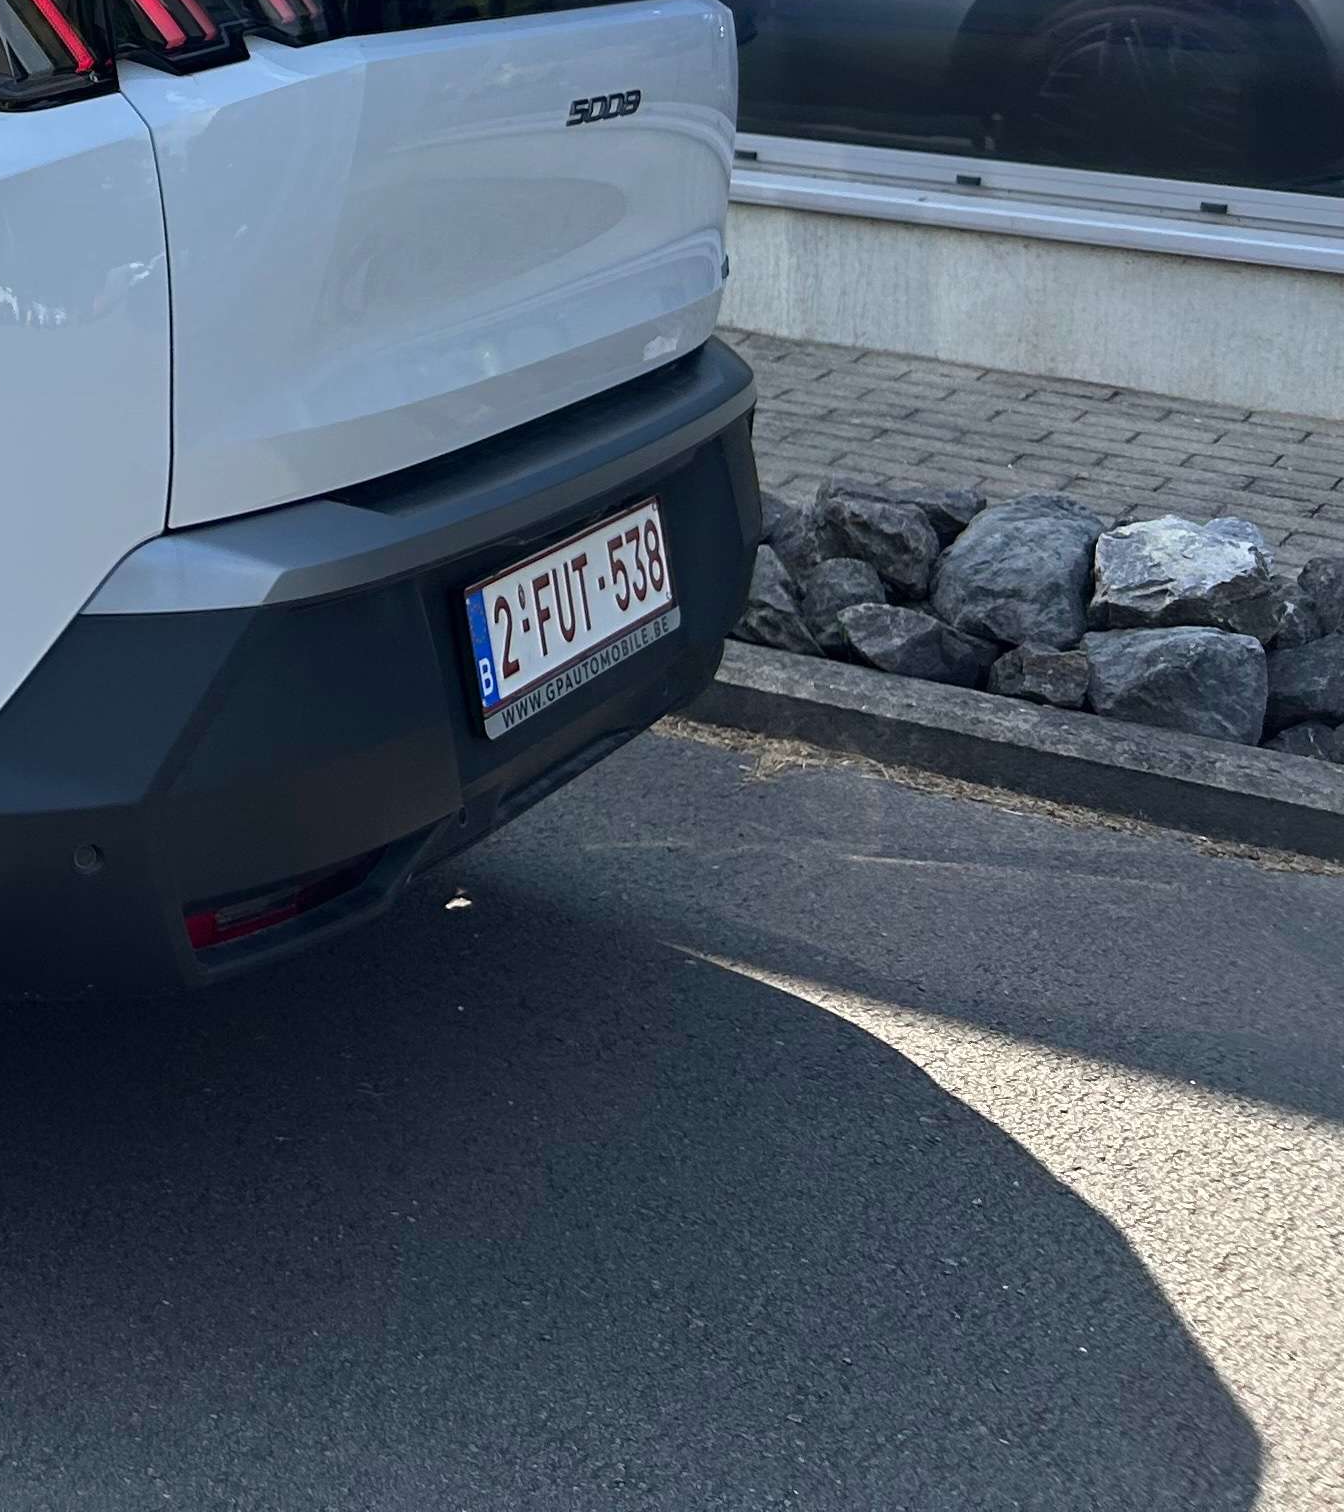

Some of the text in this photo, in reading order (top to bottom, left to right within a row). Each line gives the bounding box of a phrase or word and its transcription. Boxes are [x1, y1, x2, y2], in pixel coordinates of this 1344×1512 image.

[566, 89, 642, 127] 5008
[478, 658, 494, 697] B
[501, 615, 670, 729] WWW.GPAUTOMOBILE.BE
